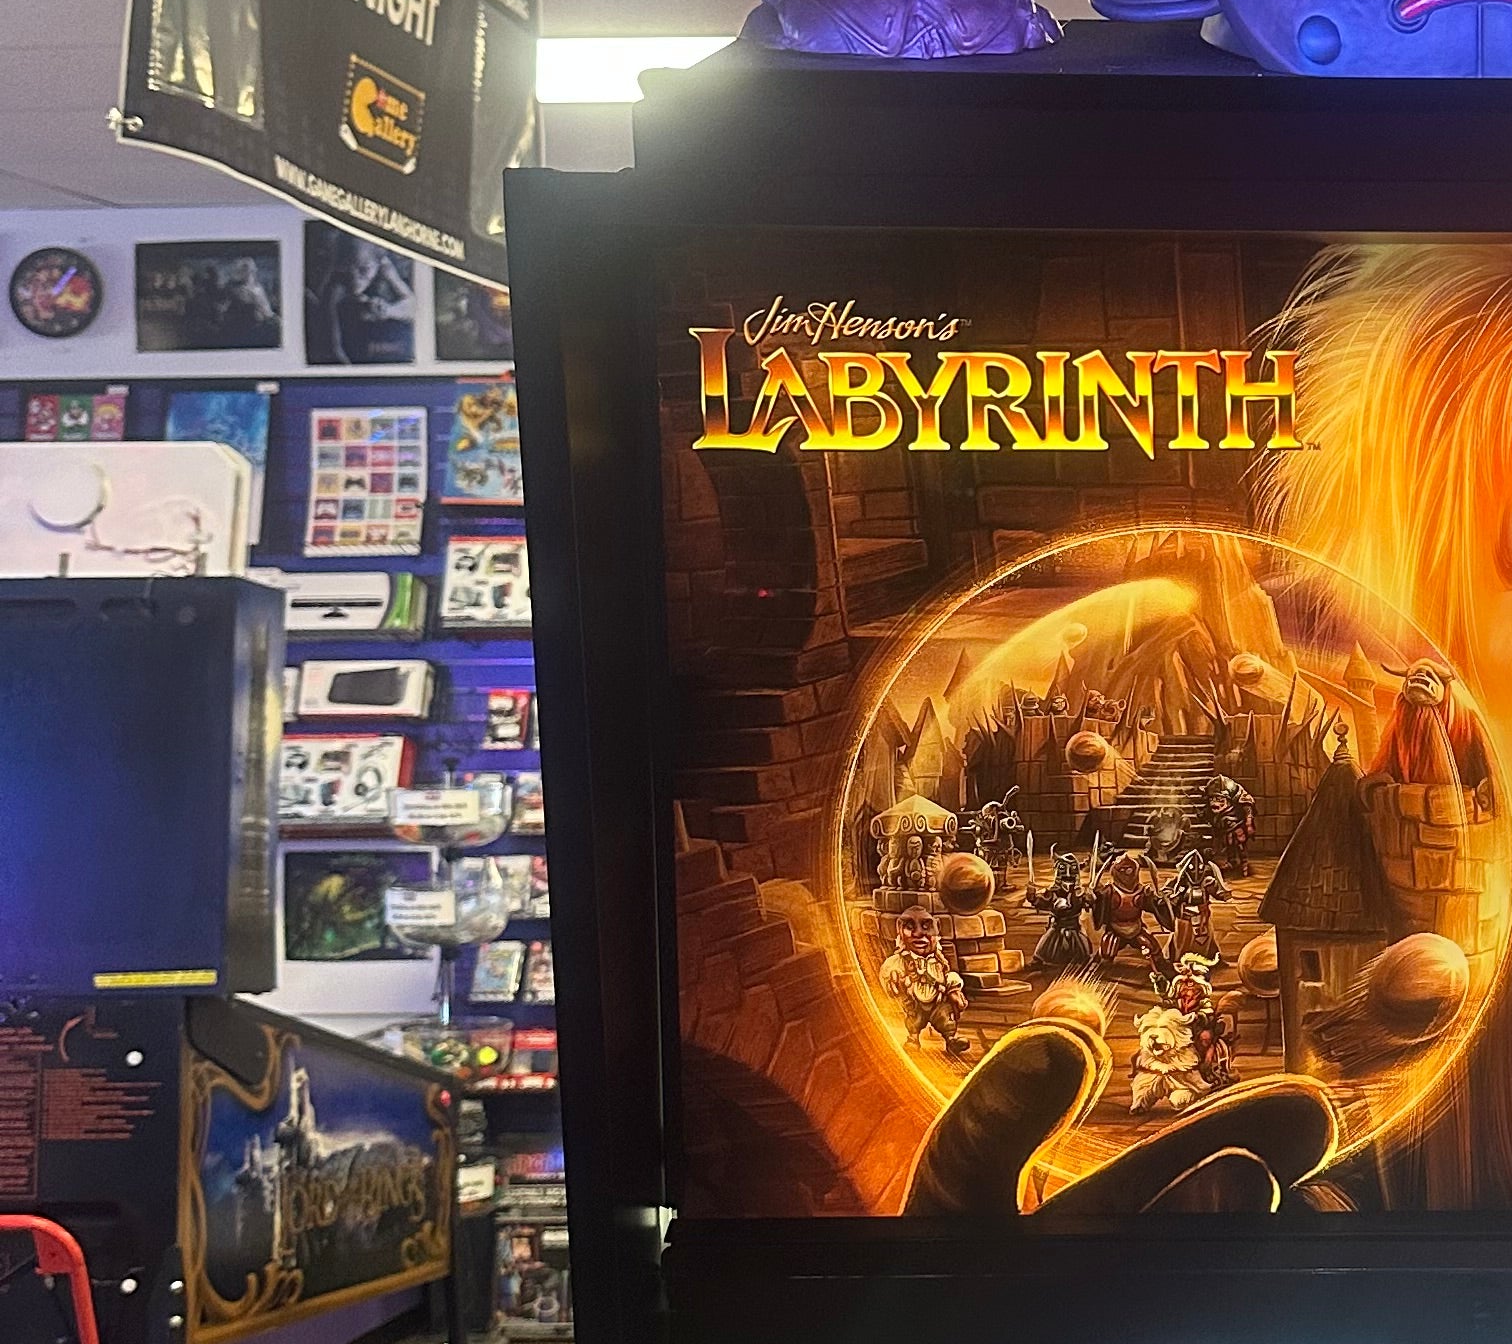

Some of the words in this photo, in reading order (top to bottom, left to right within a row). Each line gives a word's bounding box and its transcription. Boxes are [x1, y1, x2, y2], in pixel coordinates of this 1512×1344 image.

[743, 295, 815, 346] Jim
[807, 299, 960, 346] Henson's
[688, 326, 1305, 460] LABYRINTH
